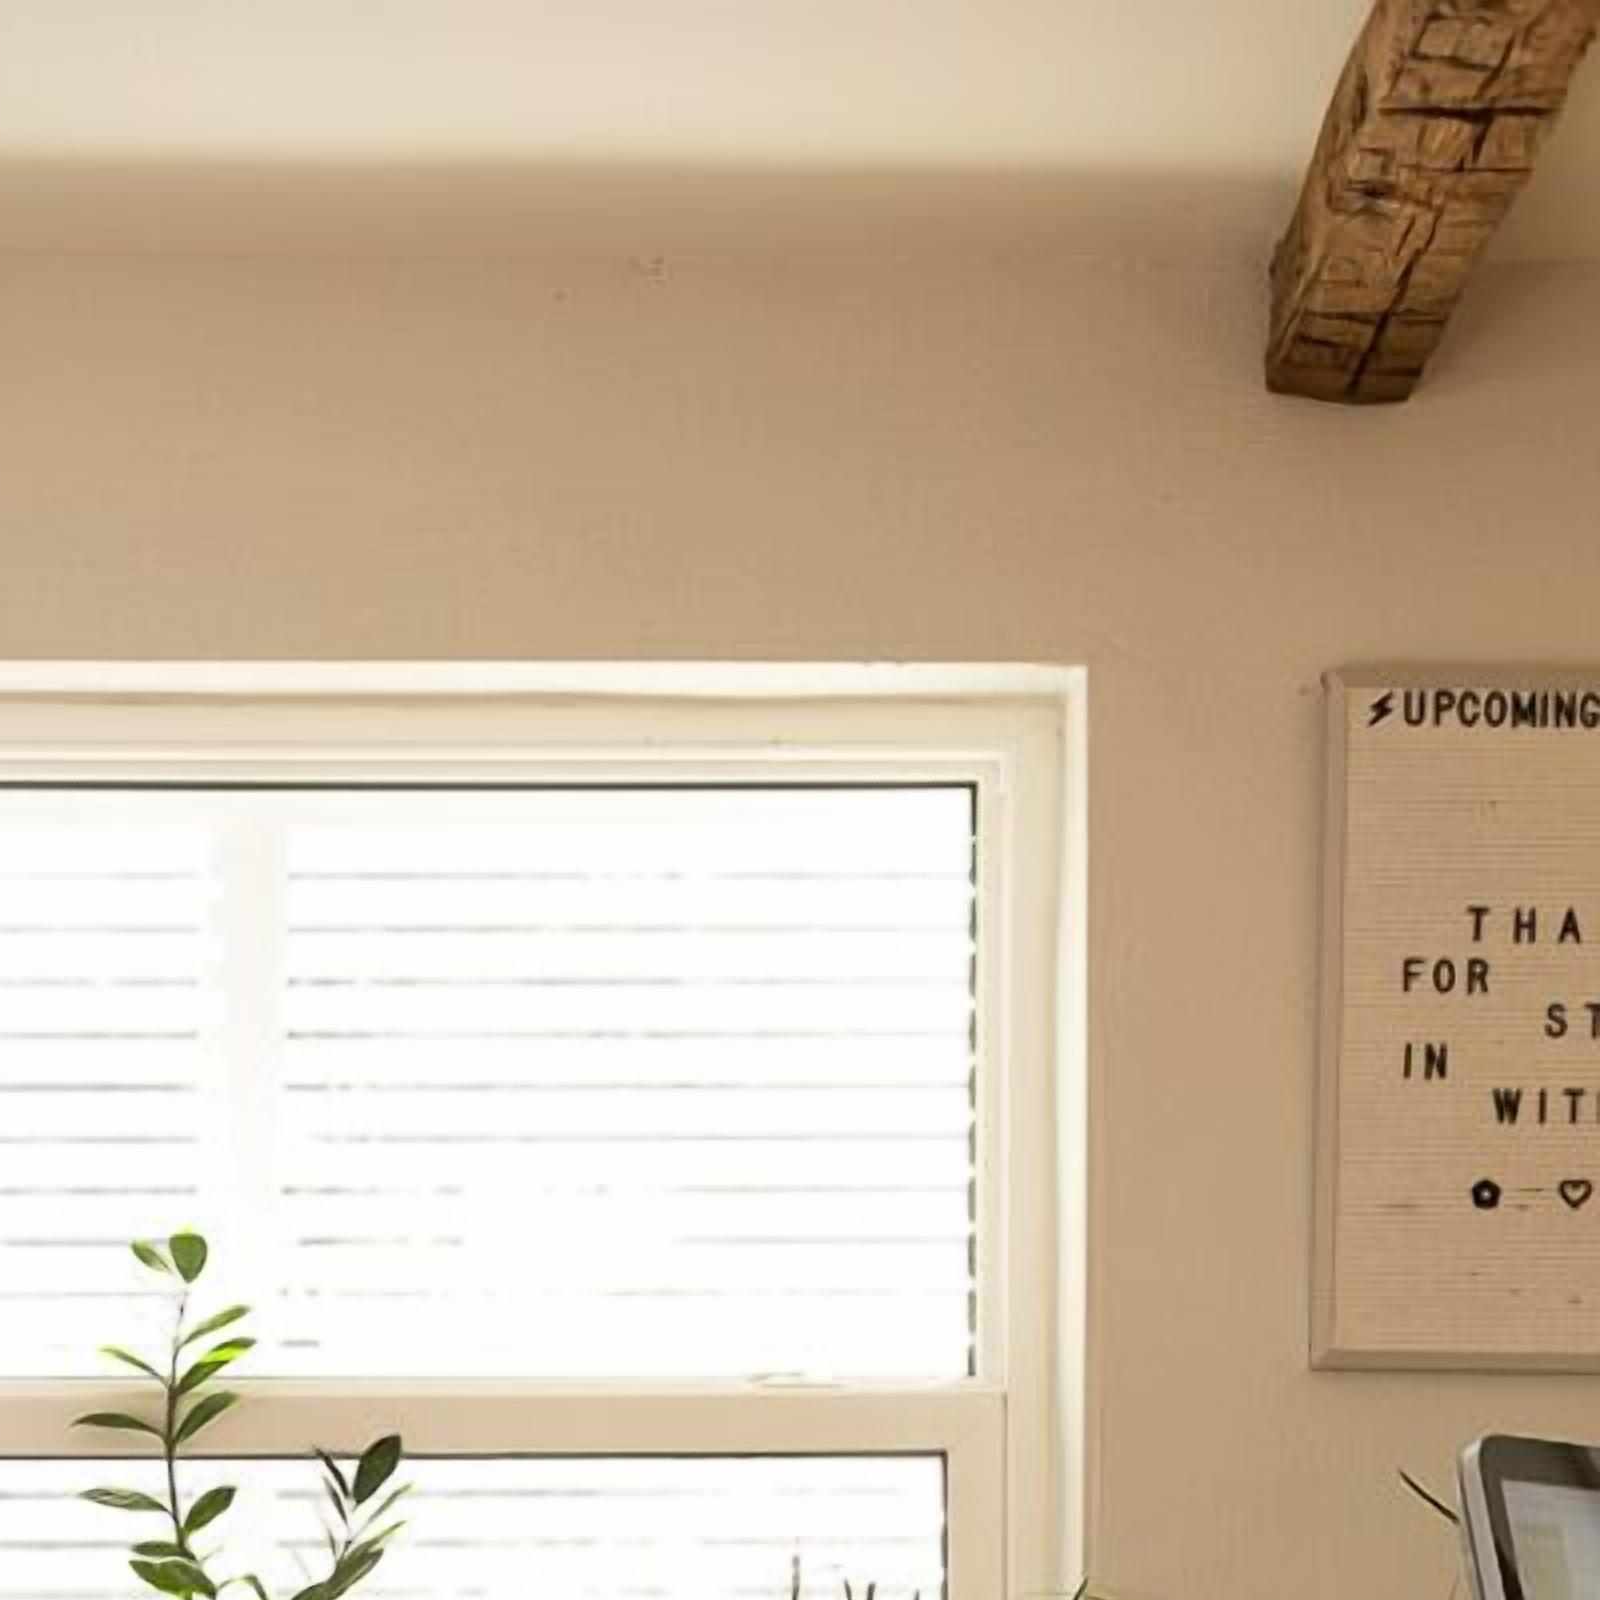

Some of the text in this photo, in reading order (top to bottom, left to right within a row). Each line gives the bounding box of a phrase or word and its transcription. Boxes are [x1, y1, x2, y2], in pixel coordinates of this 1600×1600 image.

[1403, 690, 1600, 728] UPCOMING
[1467, 906, 1581, 943] THA
[1403, 957, 1489, 994] FOR
[1403, 1043, 1448, 1080] IN
[1493, 1088, 1600, 1125] WIT
